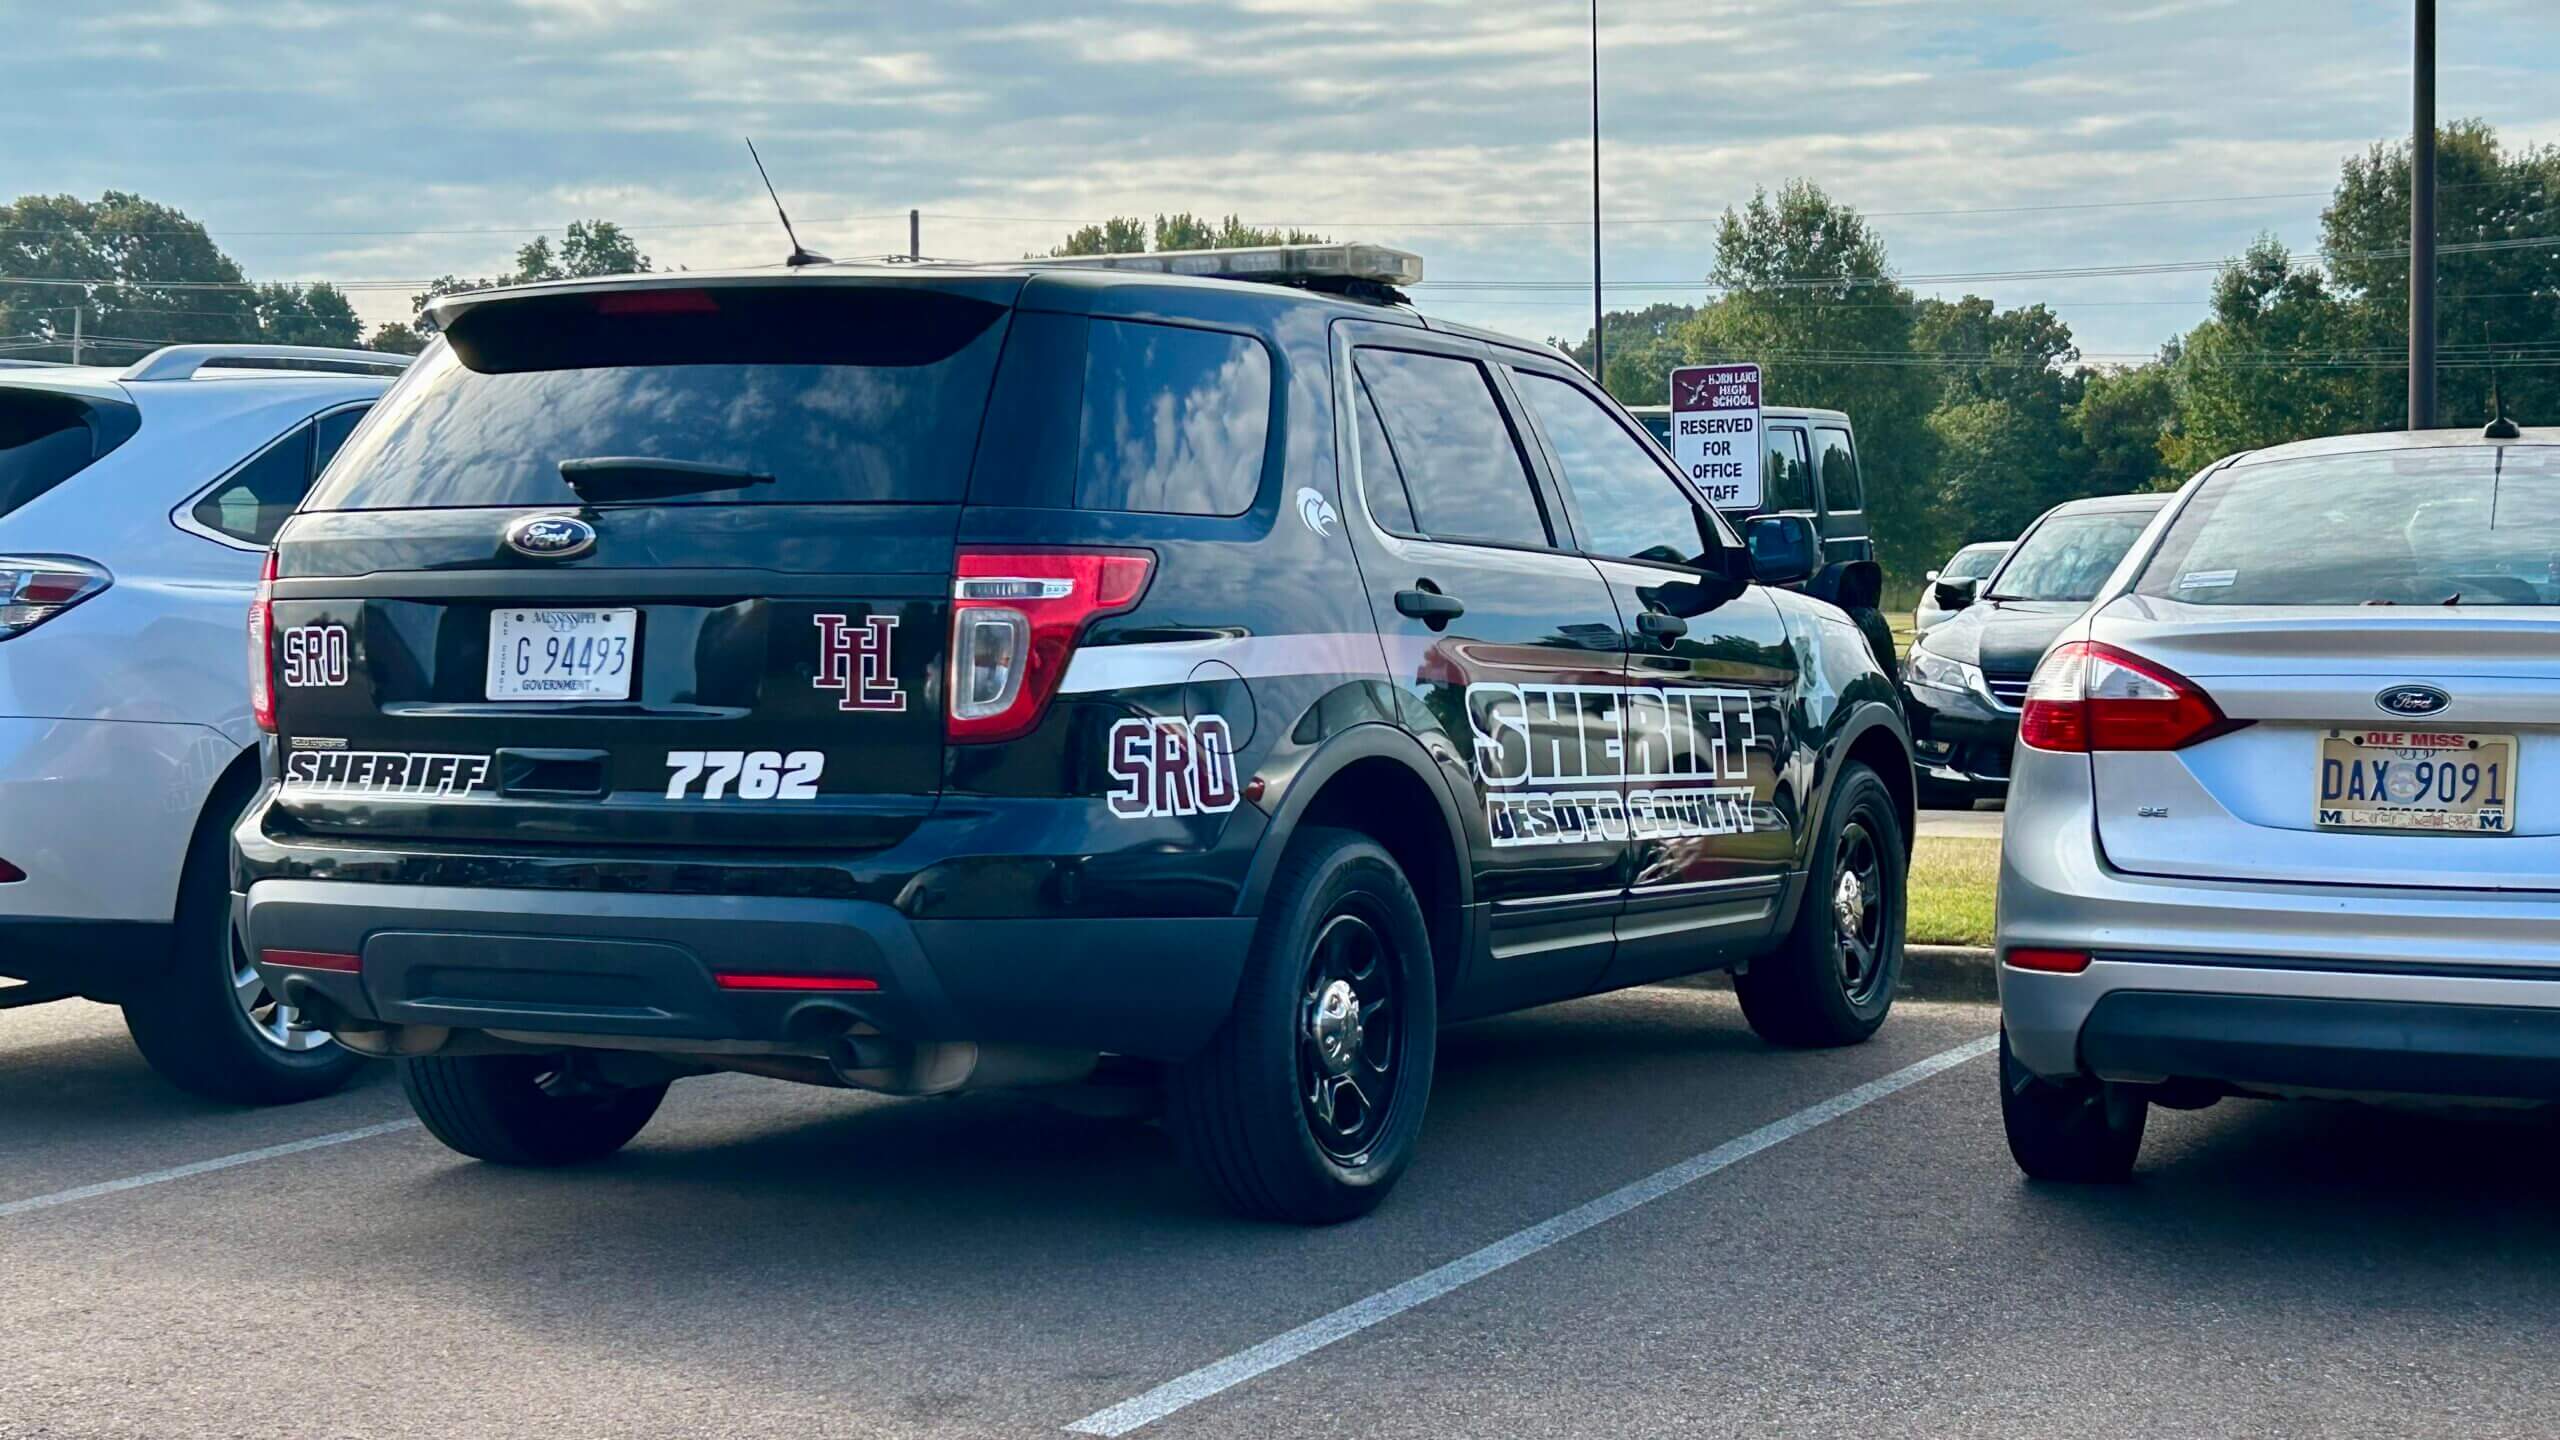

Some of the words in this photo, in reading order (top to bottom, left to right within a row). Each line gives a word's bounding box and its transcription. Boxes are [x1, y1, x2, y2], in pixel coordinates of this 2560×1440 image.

[1712, 396, 1754, 407] SCHOOL
[1719, 385, 1747, 395] HIGH
[1680, 418, 1753, 435] RESERVED
[1703, 441, 1731, 456] FOR
[1693, 463, 1742, 478] OFFICE
[524, 523, 572, 546] Ford
[284, 627, 348, 687] SRO
[517, 637, 531, 676] G
[544, 637, 627, 676] 94493
[522, 680, 592, 690] GOVERNMENT
[2393, 691, 2433, 710] Ford
[1465, 682, 1756, 786] SHERIFF
[2367, 732, 2402, 746] OLE
[2411, 734, 2465, 747] MISS
[284, 751, 491, 796] SHERIFF
[665, 751, 824, 799] 7762
[1107, 714, 1240, 819] SRO
[2322, 758, 2389, 801] DAX
[2413, 761, 2503, 805] 9091
[1486, 792, 1630, 848] DESOTO
[1626, 786, 1756, 841] COUNTY
